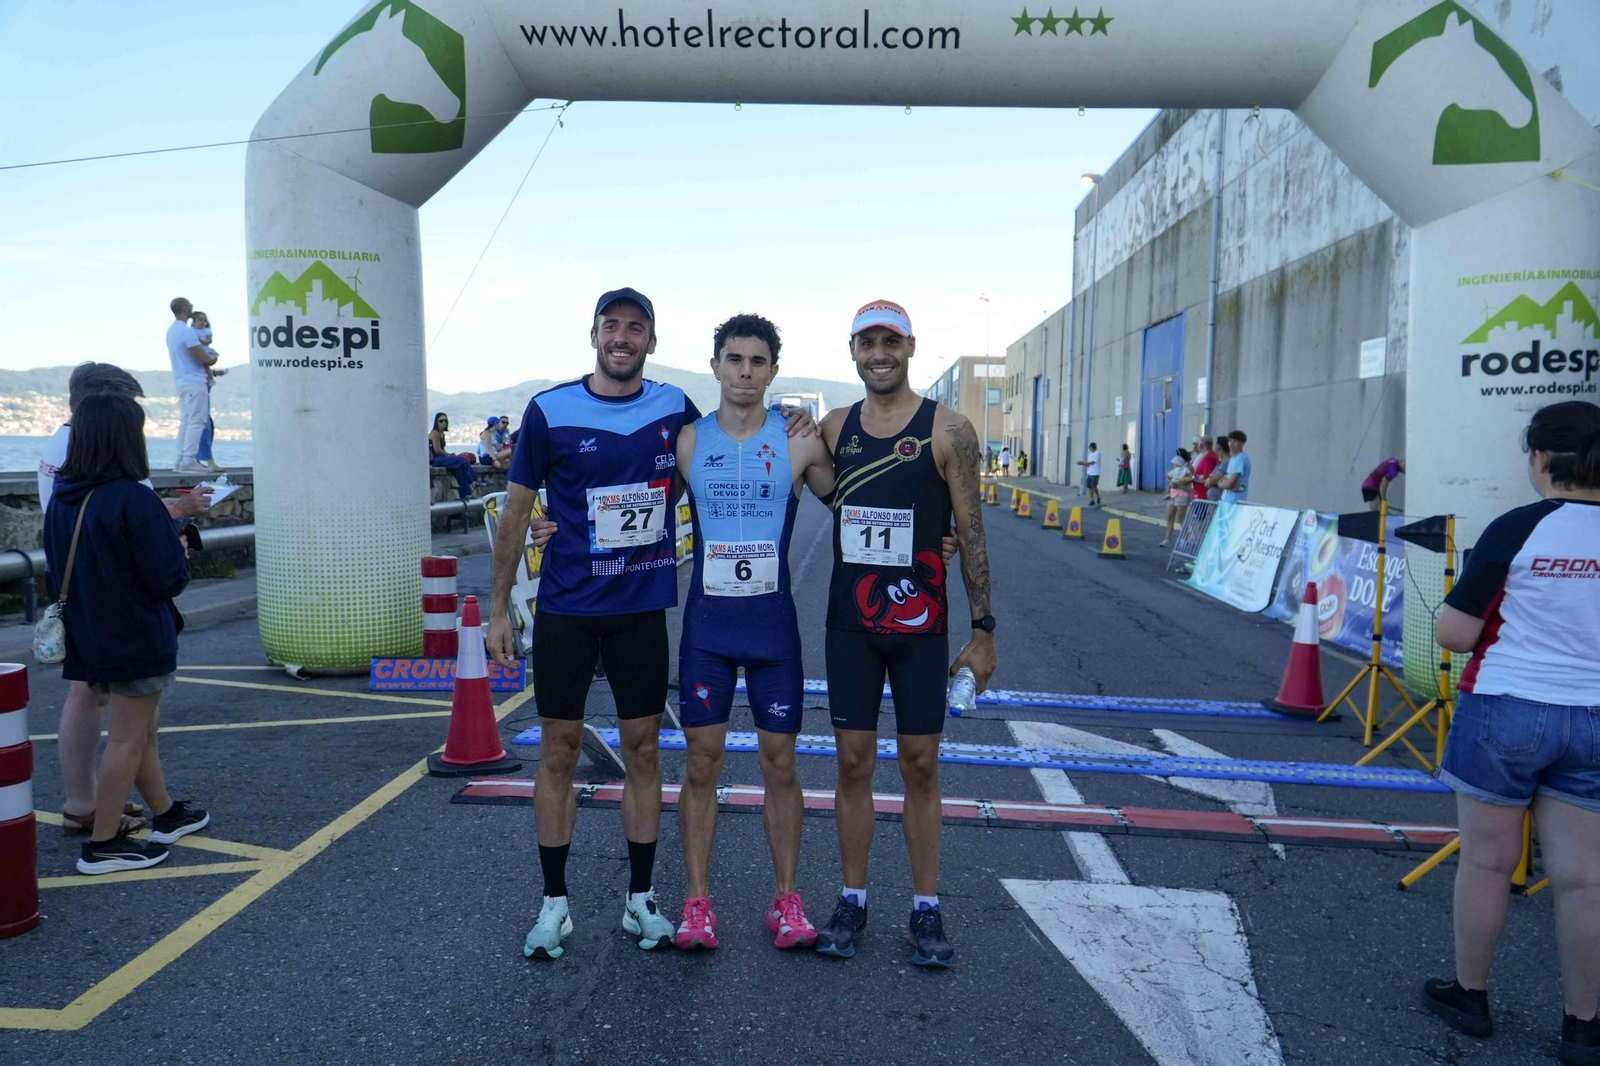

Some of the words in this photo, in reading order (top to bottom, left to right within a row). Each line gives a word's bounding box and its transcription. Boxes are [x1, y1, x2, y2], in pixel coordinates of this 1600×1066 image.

[519, 9, 961, 50] www.hotelrectoral.com
[251, 315, 380, 358] rodespi
[258, 356, 364, 371] www.rodespi.es
[1480, 381, 1597, 396] www.rodespi.es
[622, 492, 649, 502] ALFONSO
[620, 508, 653, 532] 27
[862, 510, 891, 520] ALFONSO
[893, 512, 911, 521] MORO
[860, 526, 891, 549] 11
[1260, 520, 1278, 537] Chef
[727, 544, 756, 553] ALFONSO
[758, 543, 774, 551] MORO
[1253, 537, 1282, 558] Maestro
[735, 560, 752, 581] 6
[375, 659, 520, 680] CRONEC
[768, 708, 786, 718] ZICO
